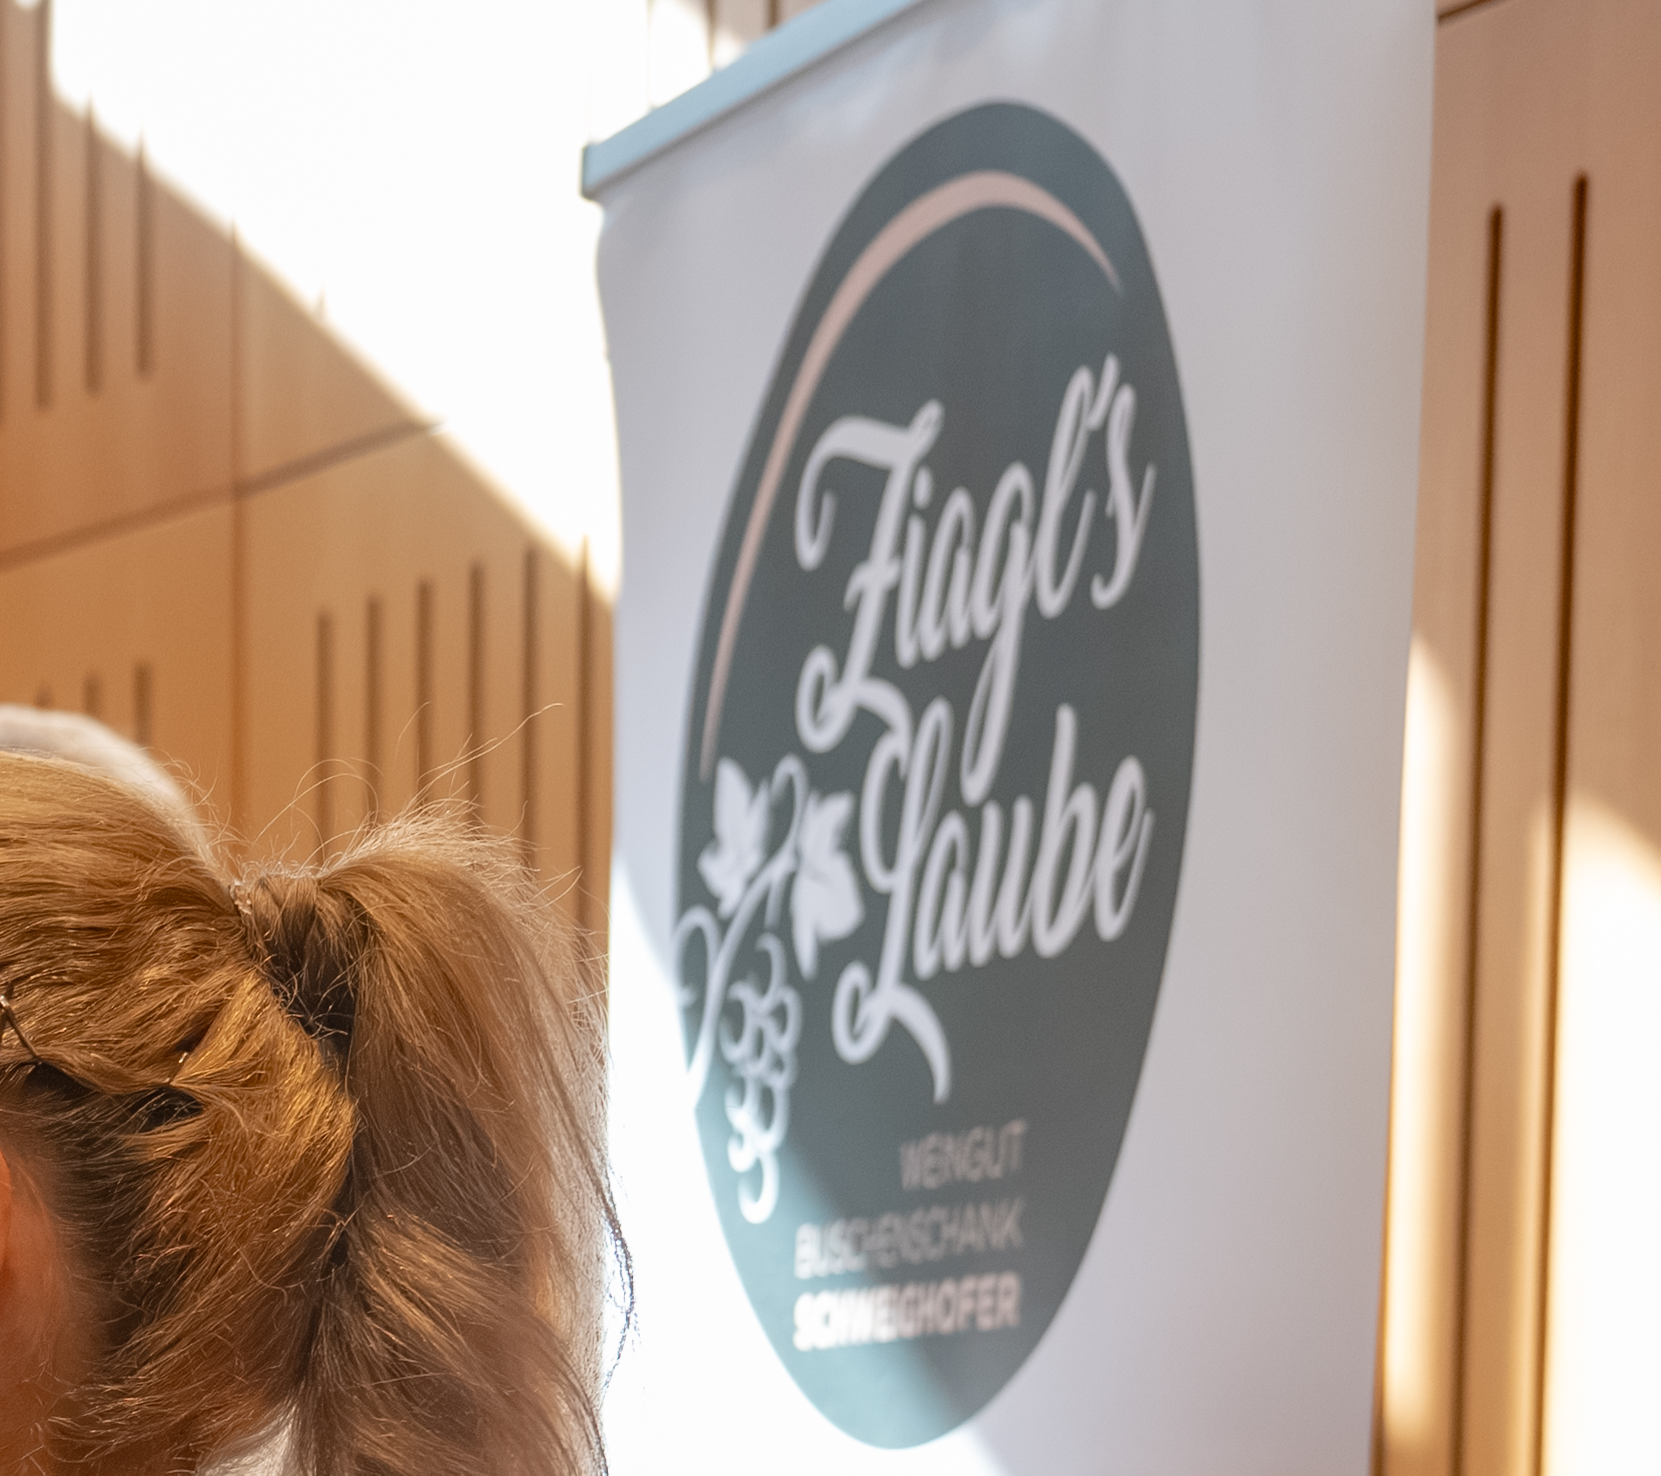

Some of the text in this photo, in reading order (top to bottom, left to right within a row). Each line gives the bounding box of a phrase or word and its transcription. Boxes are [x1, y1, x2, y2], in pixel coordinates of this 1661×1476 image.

[833, 690, 1155, 1104] Laube
[899, 1118, 1027, 1190] WEINGUT
[794, 1197, 1025, 1279] BUSCHENSCHANK
[792, 1271, 1022, 1351] SCHWEIGHOFER
